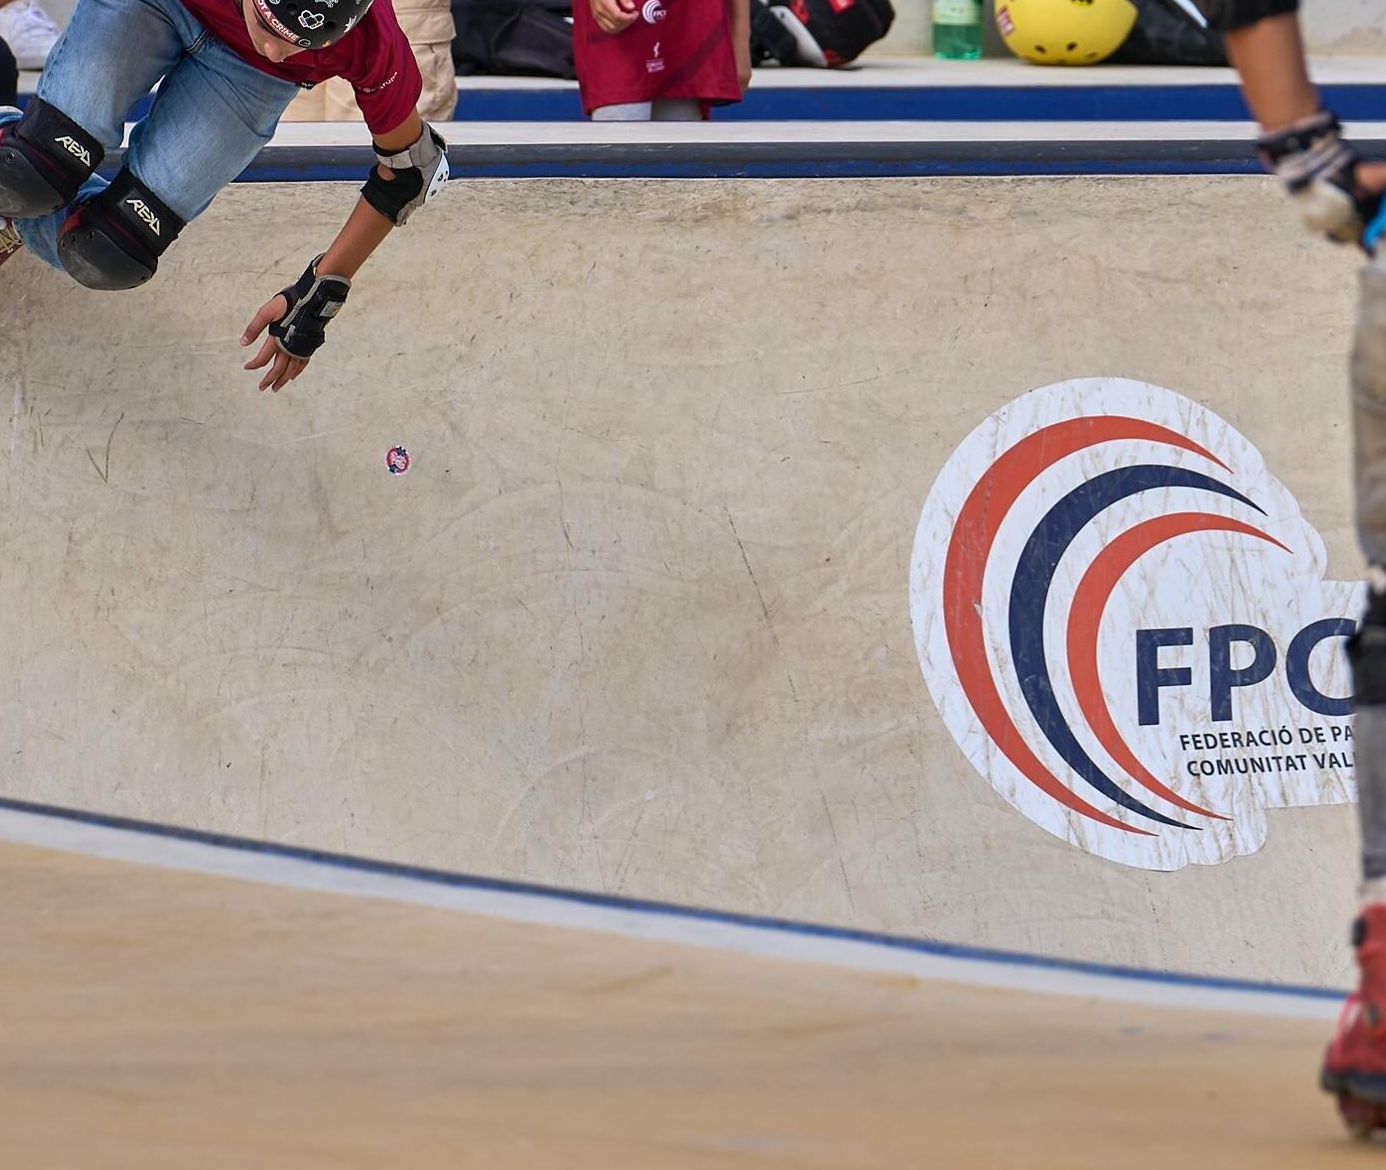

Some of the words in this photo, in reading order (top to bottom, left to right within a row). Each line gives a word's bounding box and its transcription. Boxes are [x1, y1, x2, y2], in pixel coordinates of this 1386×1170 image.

[271, 18, 300, 41] CRIME
[1179, 726, 1294, 752] FEDERACIÓ
[1298, 726, 1326, 744] DE
[1186, 754, 1308, 777] COMUNITAT
